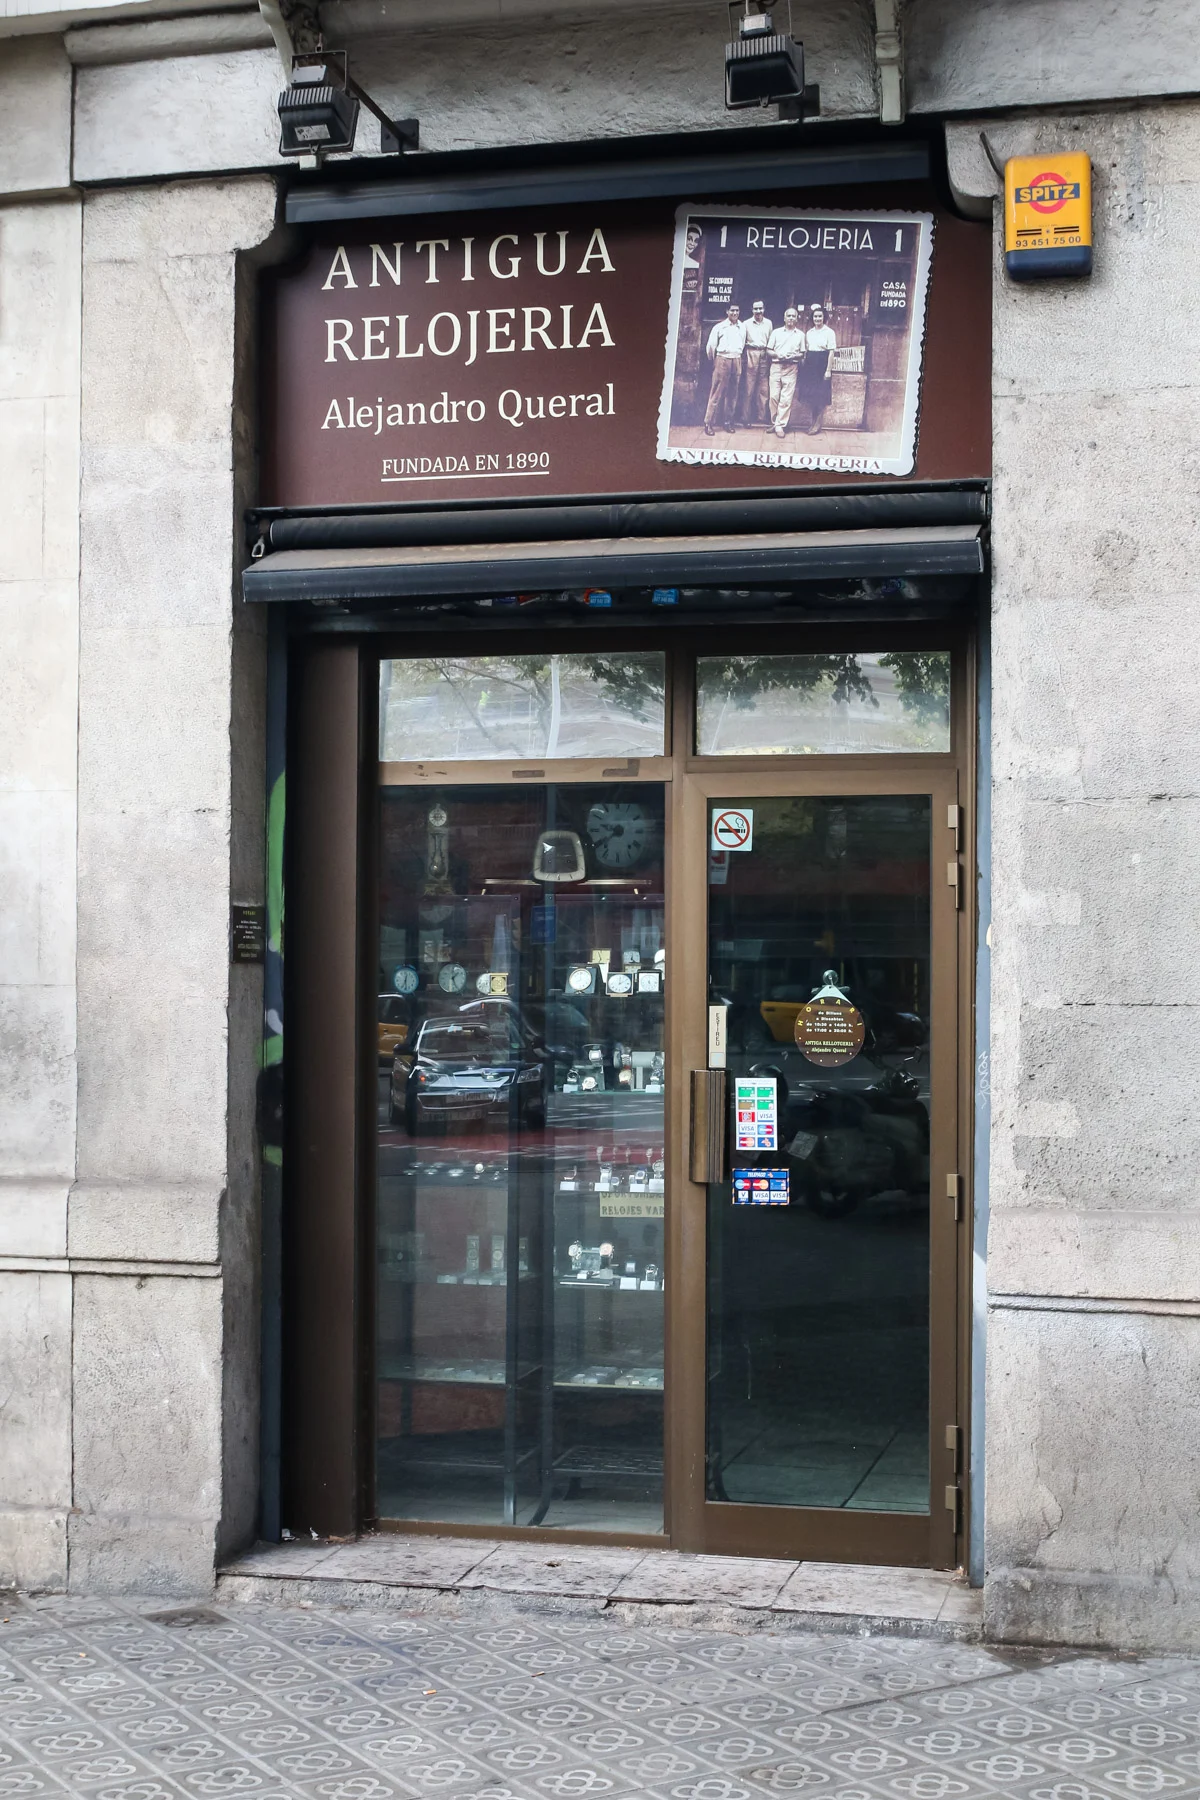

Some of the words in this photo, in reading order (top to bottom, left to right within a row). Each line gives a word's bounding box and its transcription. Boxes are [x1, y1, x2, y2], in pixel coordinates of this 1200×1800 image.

[1019, 185, 1075, 202] SPITZ
[720, 225, 728, 248] 1
[746, 226, 874, 251] RELOJERIA
[894, 228, 903, 252] 1
[1015, 239, 1028, 248] 93
[1031, 238, 1049, 246] 451
[1053, 237, 1066, 245] 75
[1068, 235, 1081, 244] 00
[321, 227, 616, 290] ANTIGUA
[881, 290, 906, 298] FUNDADA
[882, 281, 906, 290] CASA
[885, 299, 906, 308] 1890
[324, 303, 616, 366] RELOJERIA
[320, 392, 485, 436] Alejandro
[498, 383, 616, 428] Queral
[381, 455, 470, 475] FUNDADA
[475, 454, 500, 471] EN
[506, 452, 550, 470] 1890
[672, 449, 740, 463] ANTIGA
[753, 453, 881, 470] RELLOTGERIA
[601, 1205, 643, 1215] RELOJES
